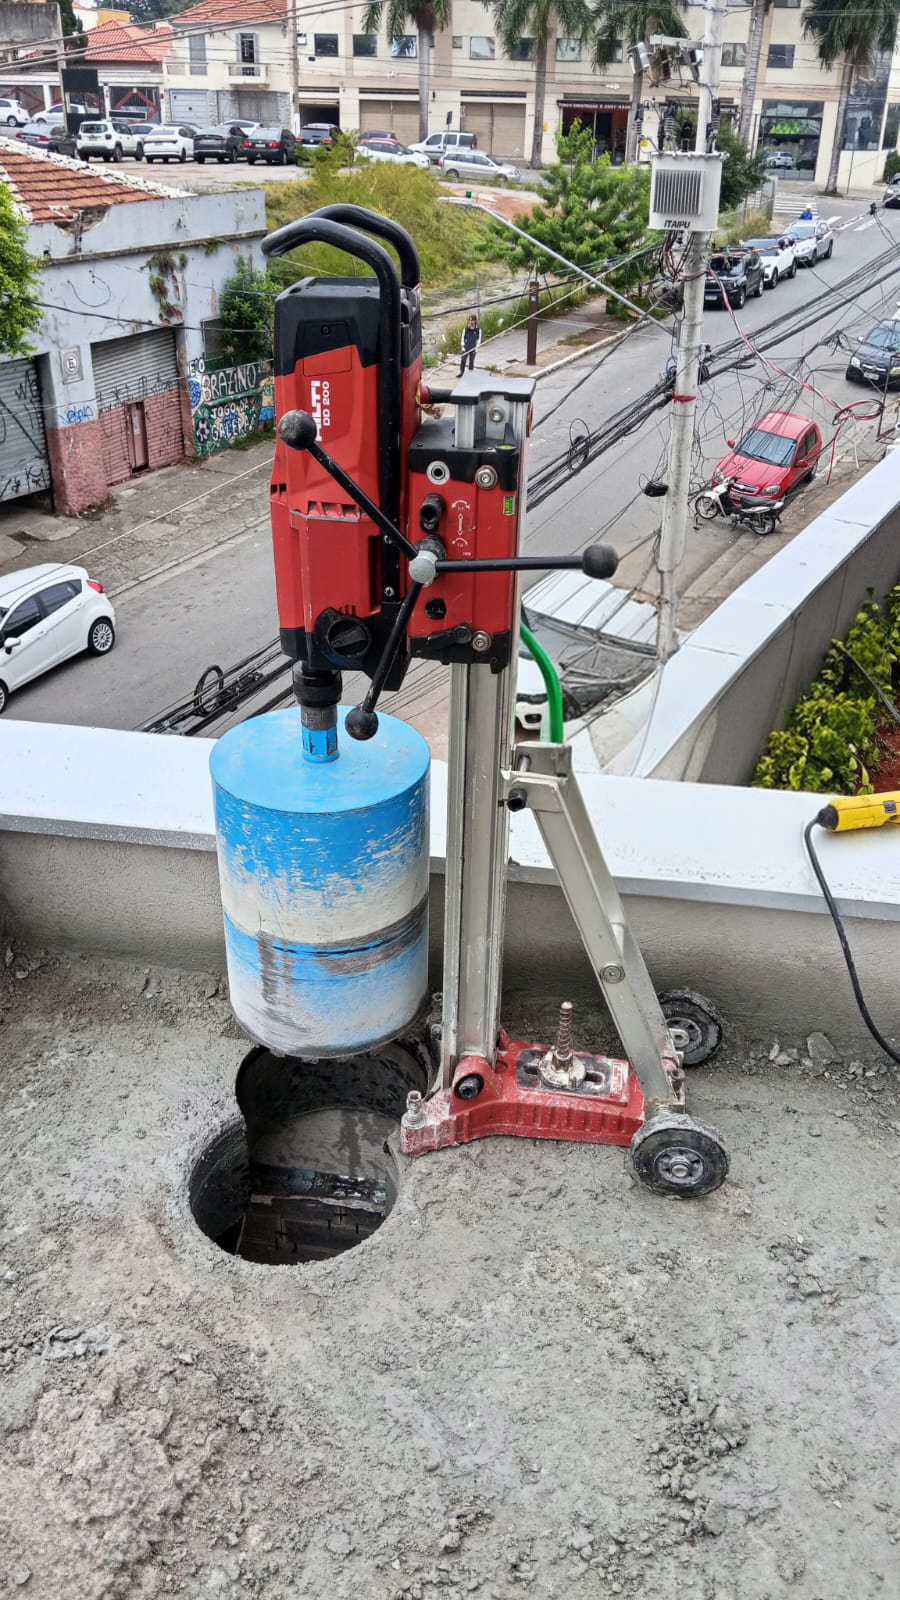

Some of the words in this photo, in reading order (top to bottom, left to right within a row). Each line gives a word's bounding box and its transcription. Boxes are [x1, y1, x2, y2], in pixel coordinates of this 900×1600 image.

[663, 219, 691, 229] ITAIPU
[201, 364, 257, 402] BRAZINO
[322, 380, 330, 406] 200
[210, 402, 237, 420] JOGO
[311, 380, 323, 442] HILTI
[322, 408, 331, 426] DD
